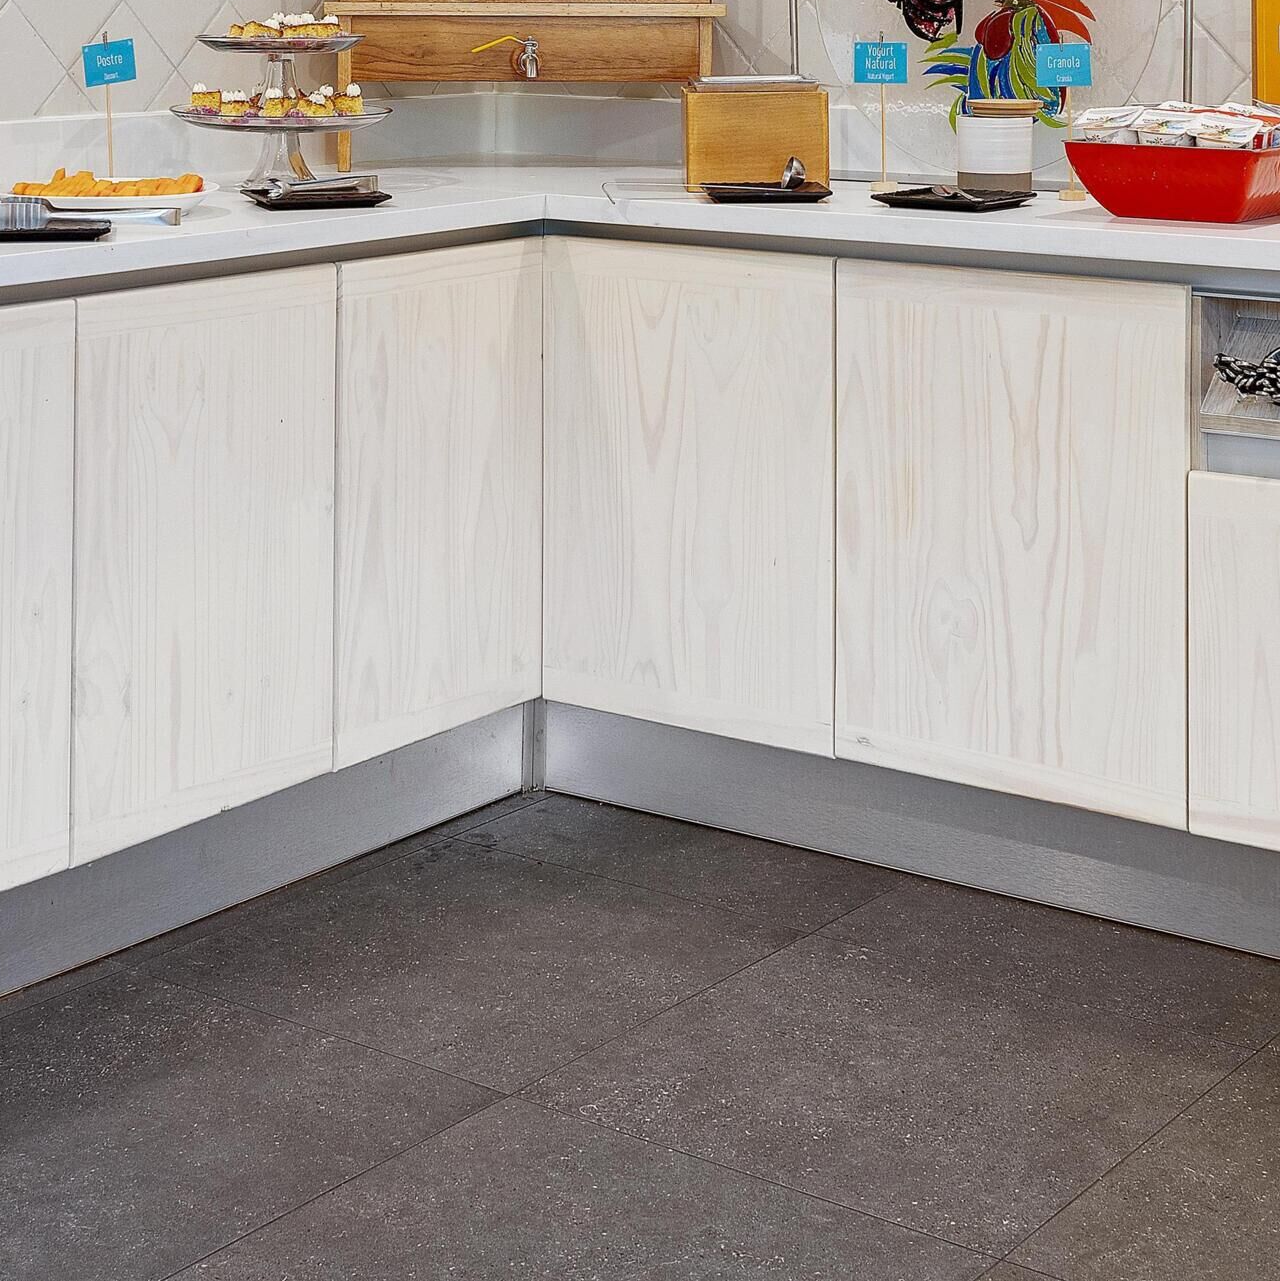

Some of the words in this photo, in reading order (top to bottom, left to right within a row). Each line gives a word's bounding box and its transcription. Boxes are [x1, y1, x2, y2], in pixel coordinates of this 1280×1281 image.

[867, 44, 894, 59] Yogurt
[96, 54, 123, 68] Postre
[865, 57, 897, 70] Natural
[1047, 55, 1081, 69] Granola
